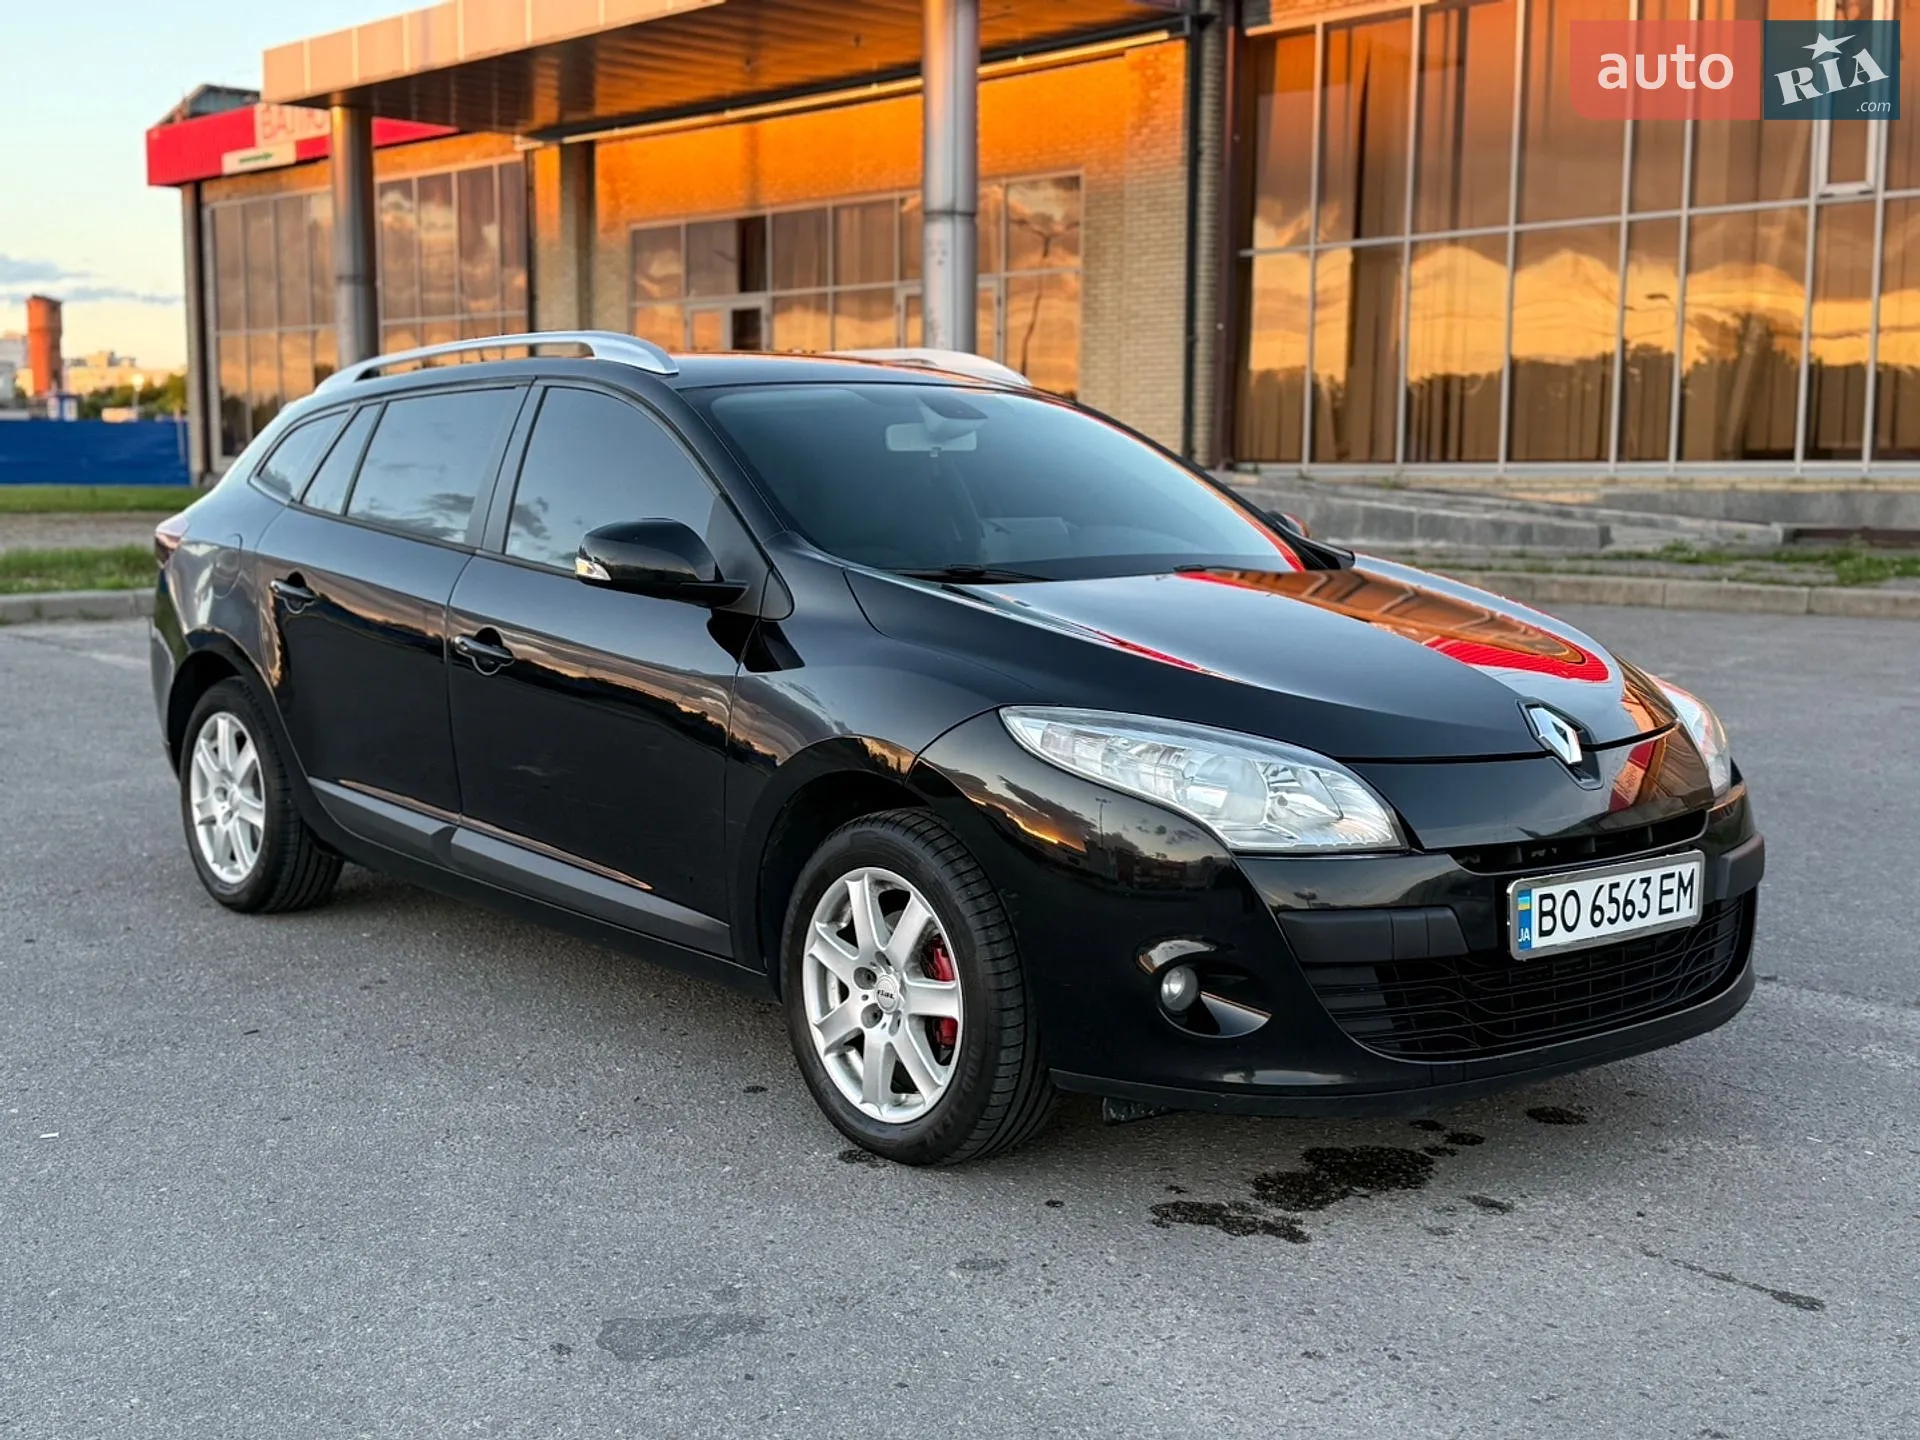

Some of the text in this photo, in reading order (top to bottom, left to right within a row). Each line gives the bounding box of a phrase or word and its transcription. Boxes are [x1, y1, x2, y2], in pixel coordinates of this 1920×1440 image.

[1538, 868, 1695, 937] BO 6563 EM
